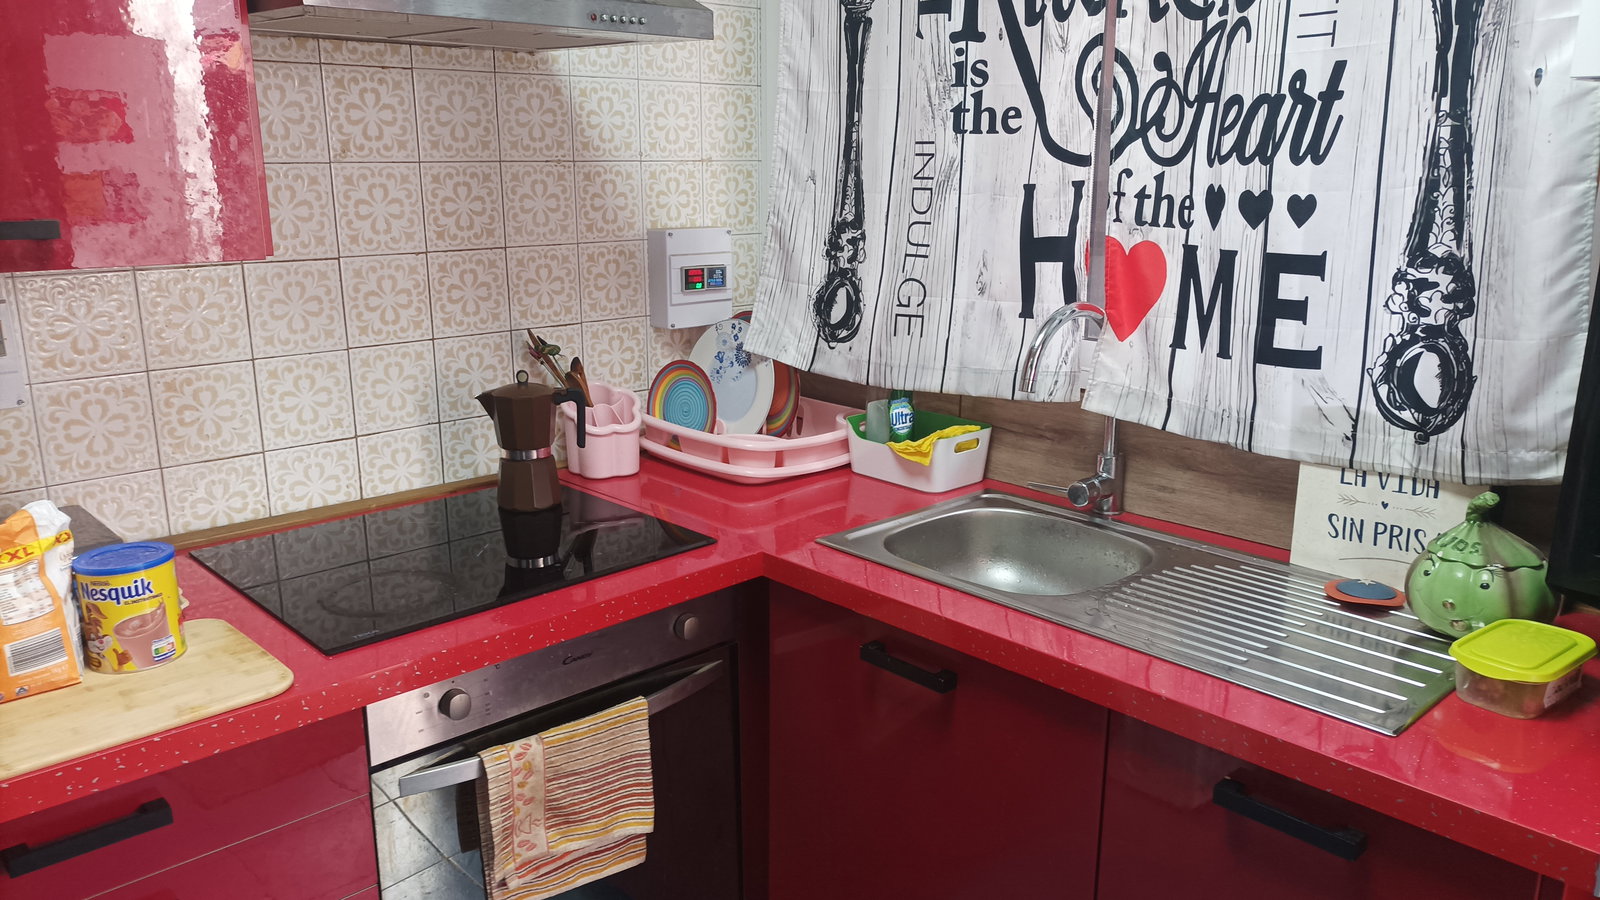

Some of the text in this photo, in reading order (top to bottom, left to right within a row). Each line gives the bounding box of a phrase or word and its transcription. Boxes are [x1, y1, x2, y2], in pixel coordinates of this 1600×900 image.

[951, 47, 989, 88] is
[1140, 15, 1347, 168] Heart
[950, 92, 1022, 135] the
[1107, 168, 1195, 230] f the
[893, 140, 935, 338] INDULGE
[891, 411, 914, 426] Ultra
[1328, 513, 1427, 554] SIN PRIS
[0, 547, 34, 563] XL
[80, 578, 153, 605] Nesquik
